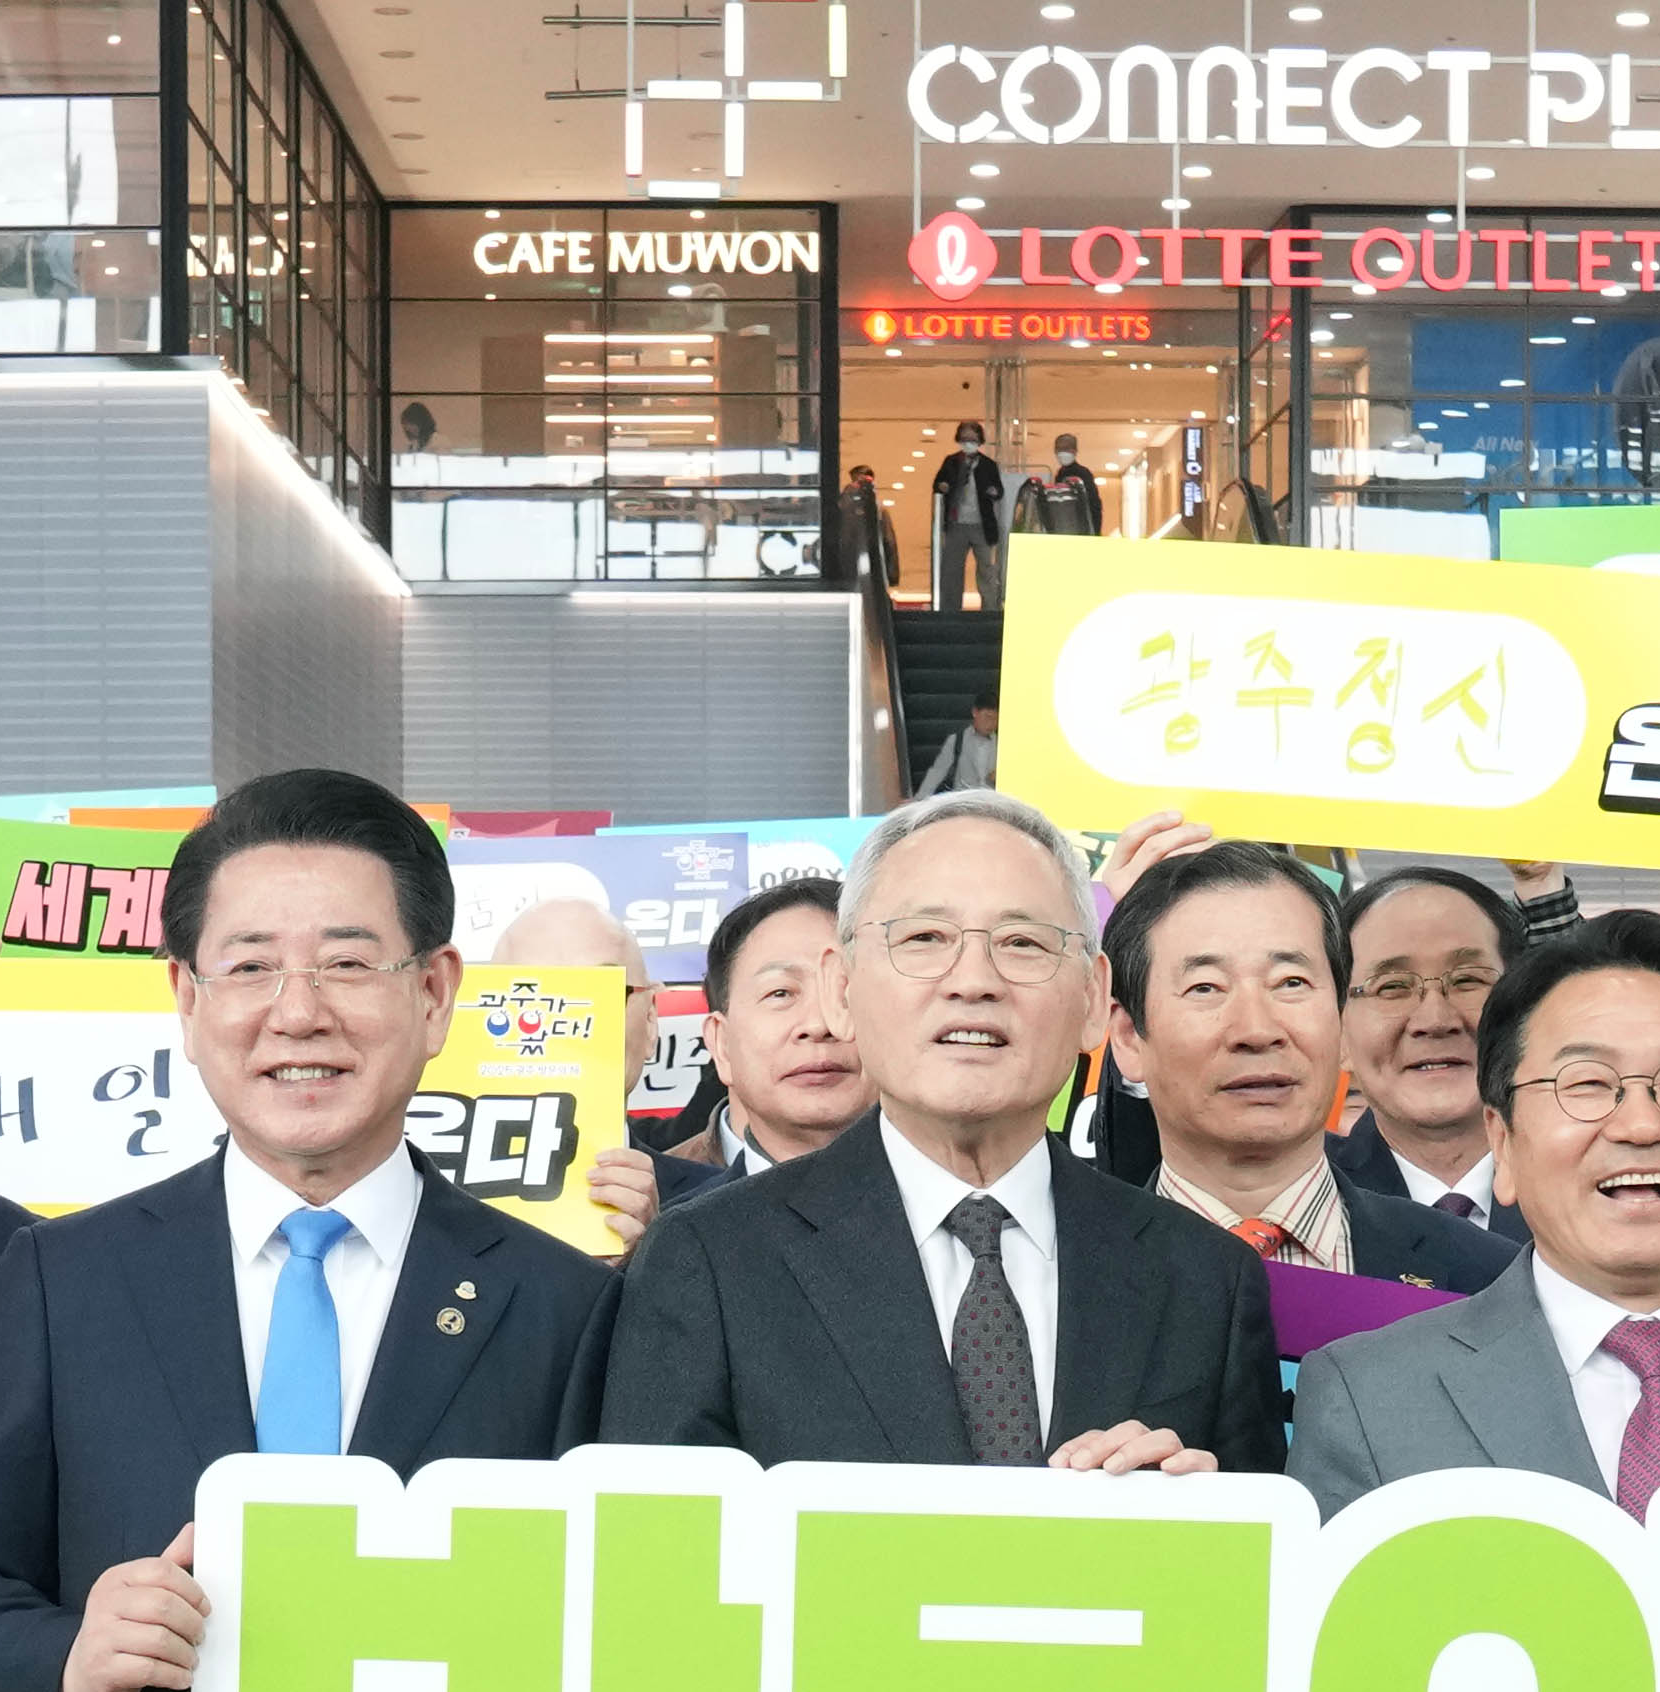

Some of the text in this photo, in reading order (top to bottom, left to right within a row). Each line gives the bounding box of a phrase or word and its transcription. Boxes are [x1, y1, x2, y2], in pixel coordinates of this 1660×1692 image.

[906, 44, 1492, 150] CONNECT
[473, 229, 820, 275] CAFE MUWON
[1019, 227, 1323, 288] LOTTE
[904, 314, 1151, 341] LOTTE OUTLETS
[624, 898, 721, 948] 온다
